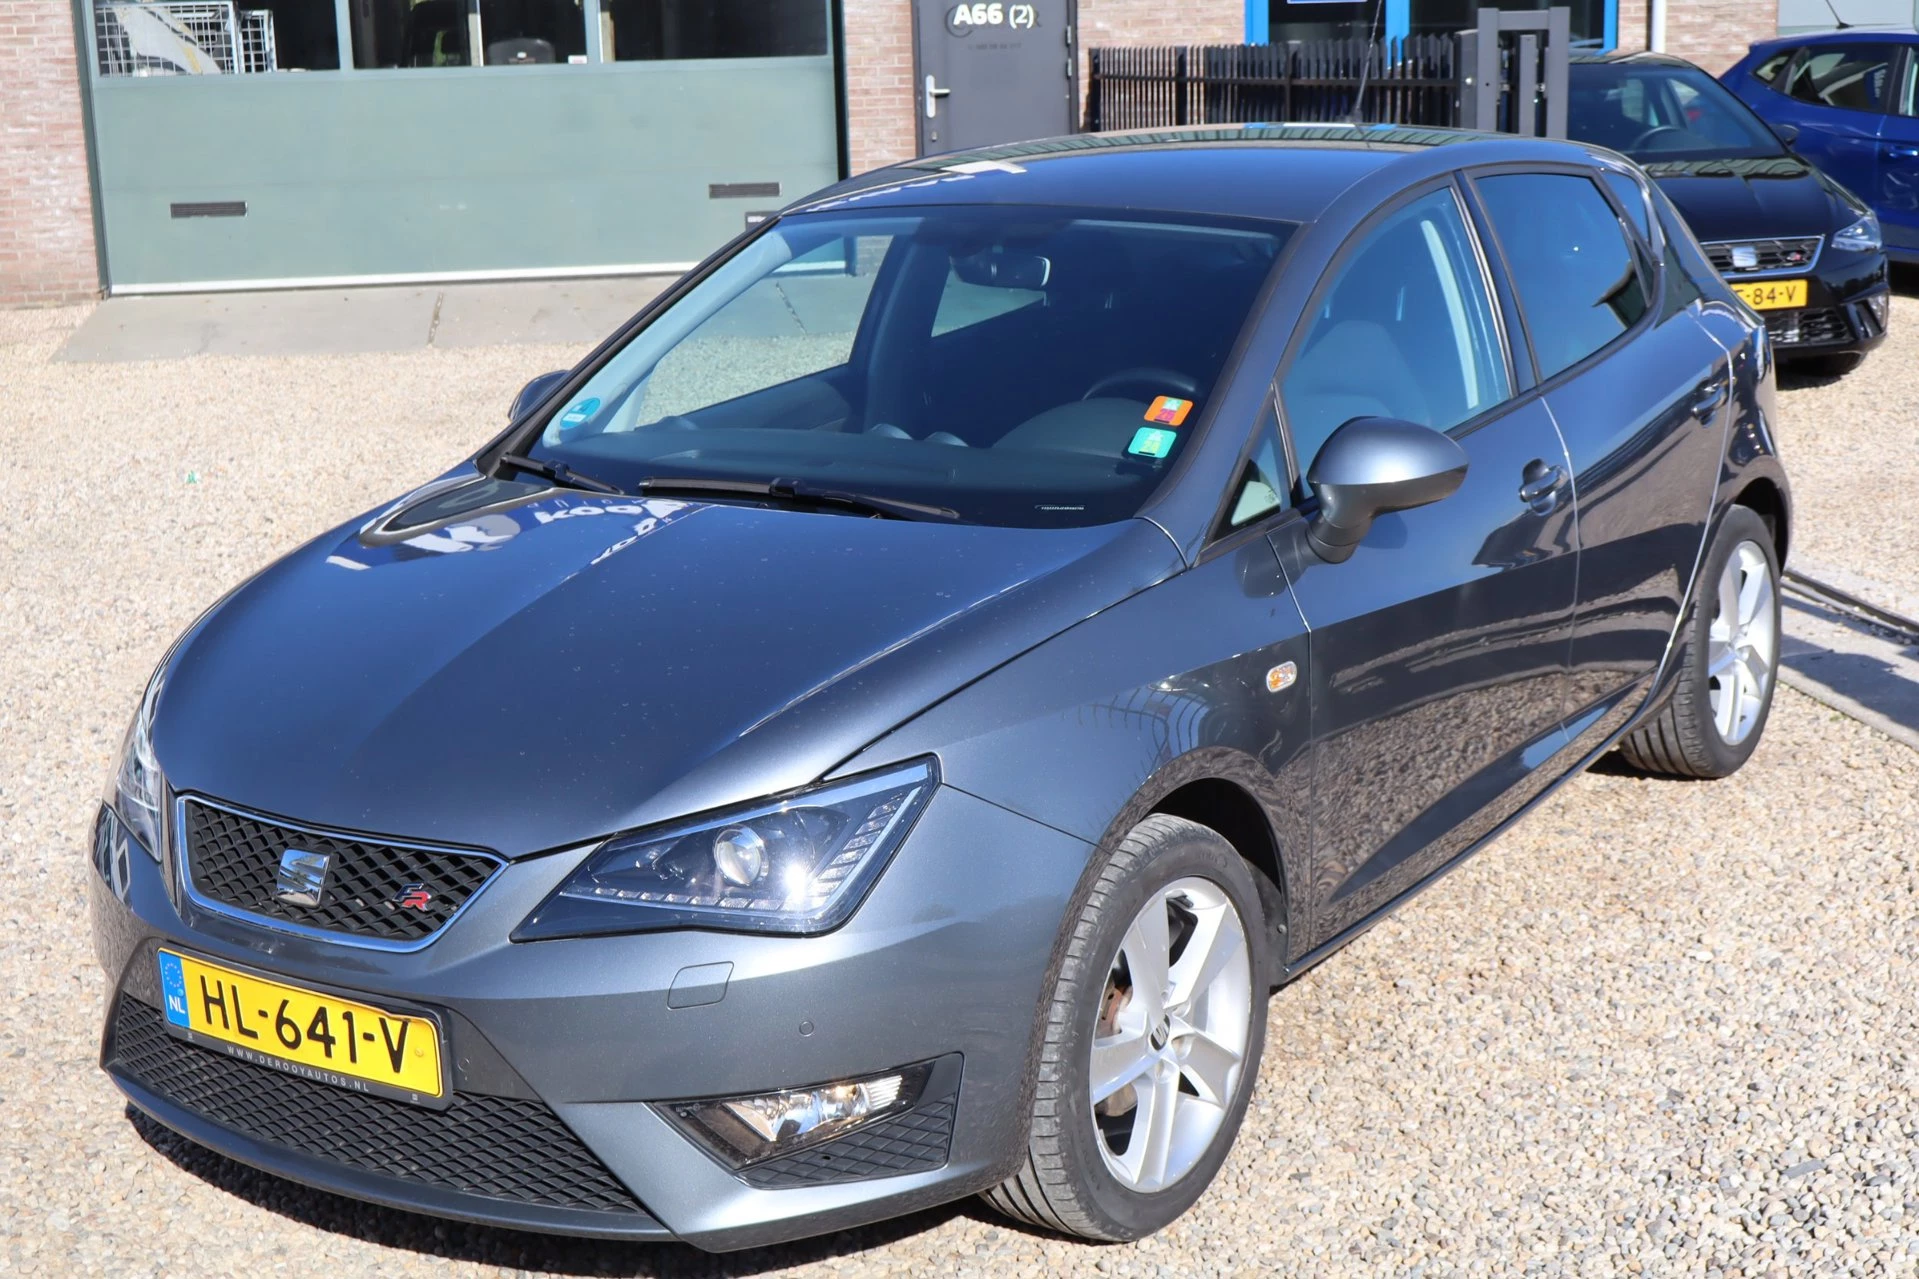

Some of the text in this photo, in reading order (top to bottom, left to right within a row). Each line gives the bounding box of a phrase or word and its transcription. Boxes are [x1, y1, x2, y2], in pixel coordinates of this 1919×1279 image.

[953, 3, 1034, 29] A66 (2)
[169, 994, 186, 1015] NL
[200, 975, 411, 1074] HL-641-V
[227, 1045, 369, 1092] WWW.DEROOYAUTOS.NL
